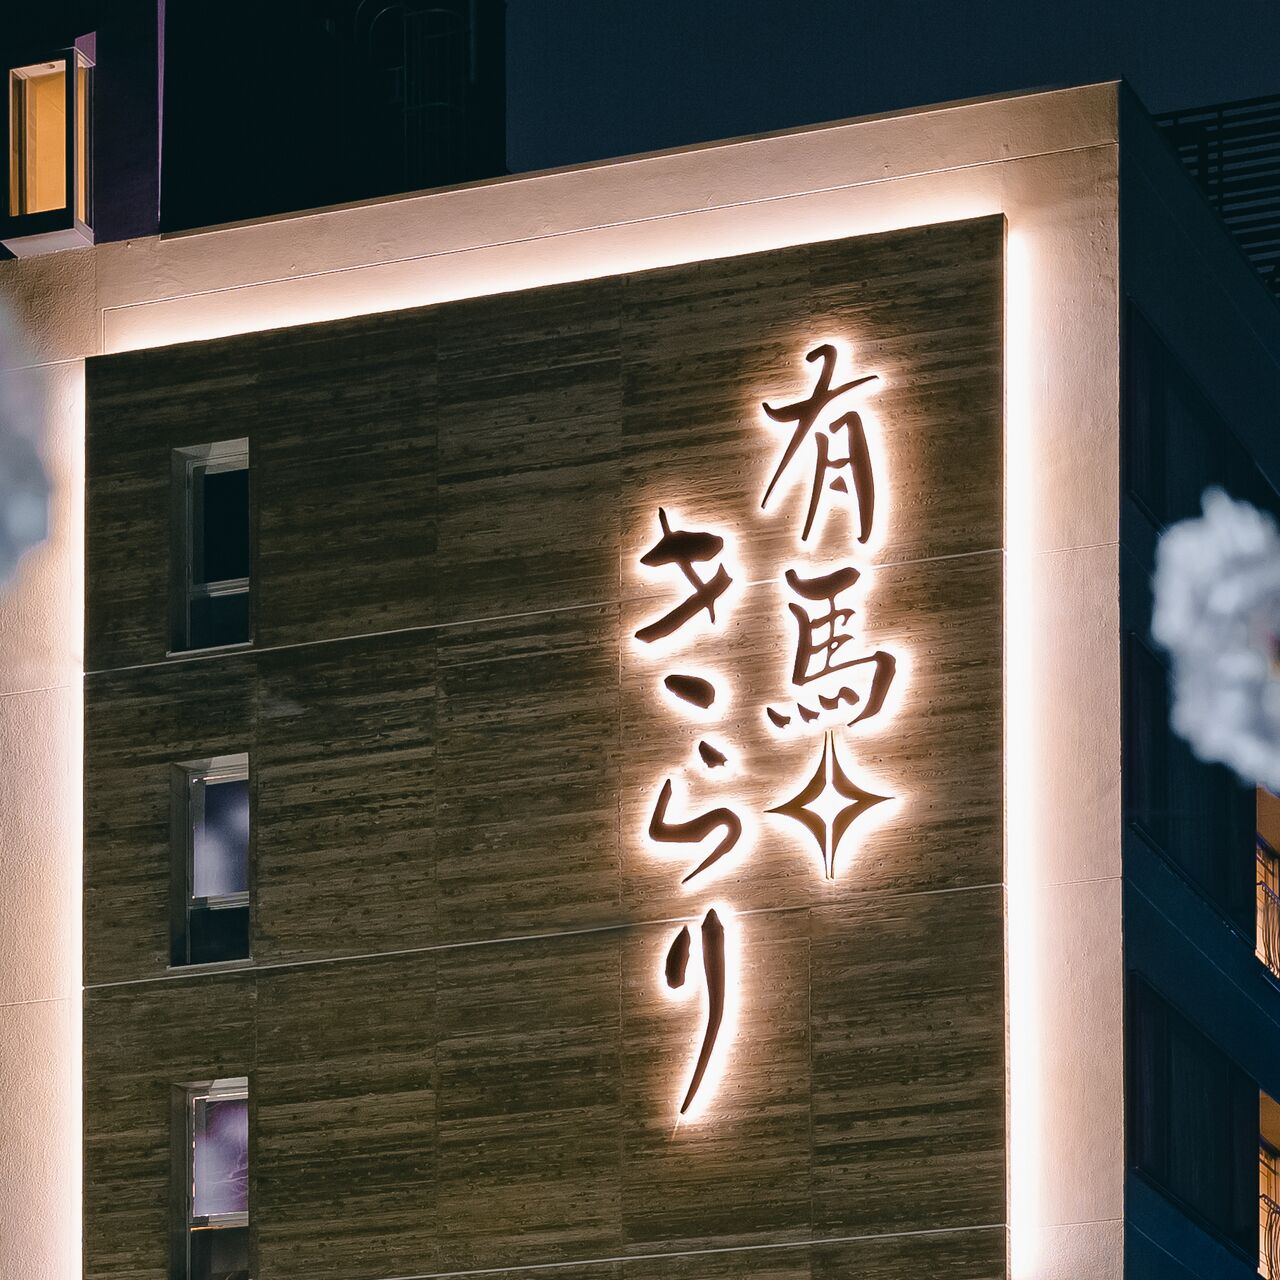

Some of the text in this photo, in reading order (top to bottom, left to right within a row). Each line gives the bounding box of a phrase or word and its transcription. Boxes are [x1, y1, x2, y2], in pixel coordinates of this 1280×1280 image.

[761, 343, 896, 728] 有馬
[635, 506, 742, 1114] きらり
